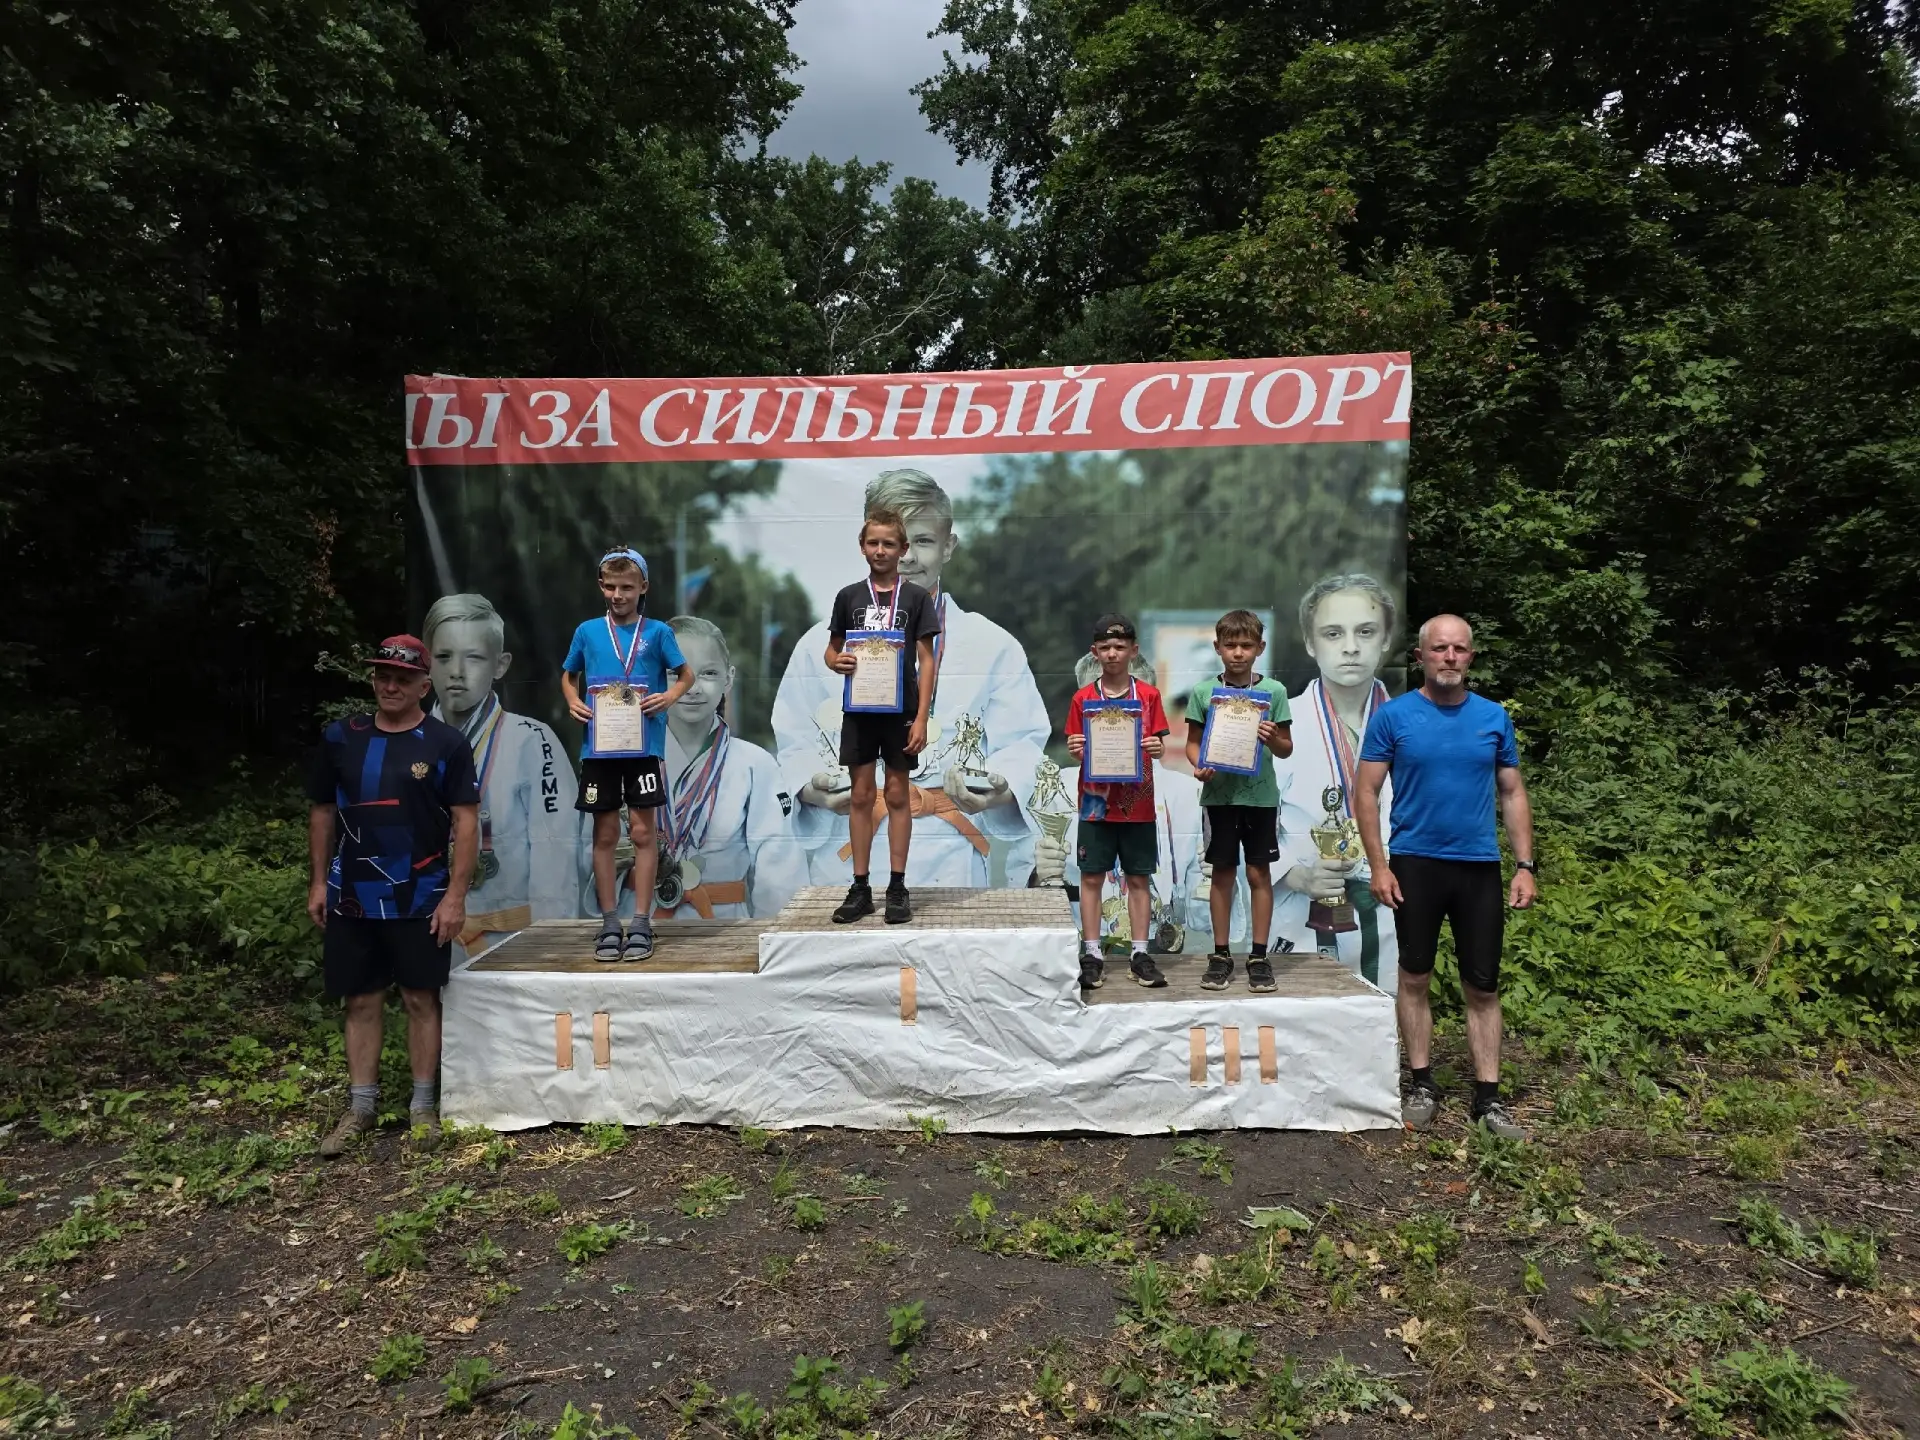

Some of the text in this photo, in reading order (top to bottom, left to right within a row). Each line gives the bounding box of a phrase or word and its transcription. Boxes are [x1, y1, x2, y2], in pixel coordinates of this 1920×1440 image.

[519, 388, 619, 448] ЗА
[640, 365, 1106, 447] СИЛЬНЫЙ
[637, 772, 657, 795] 10
